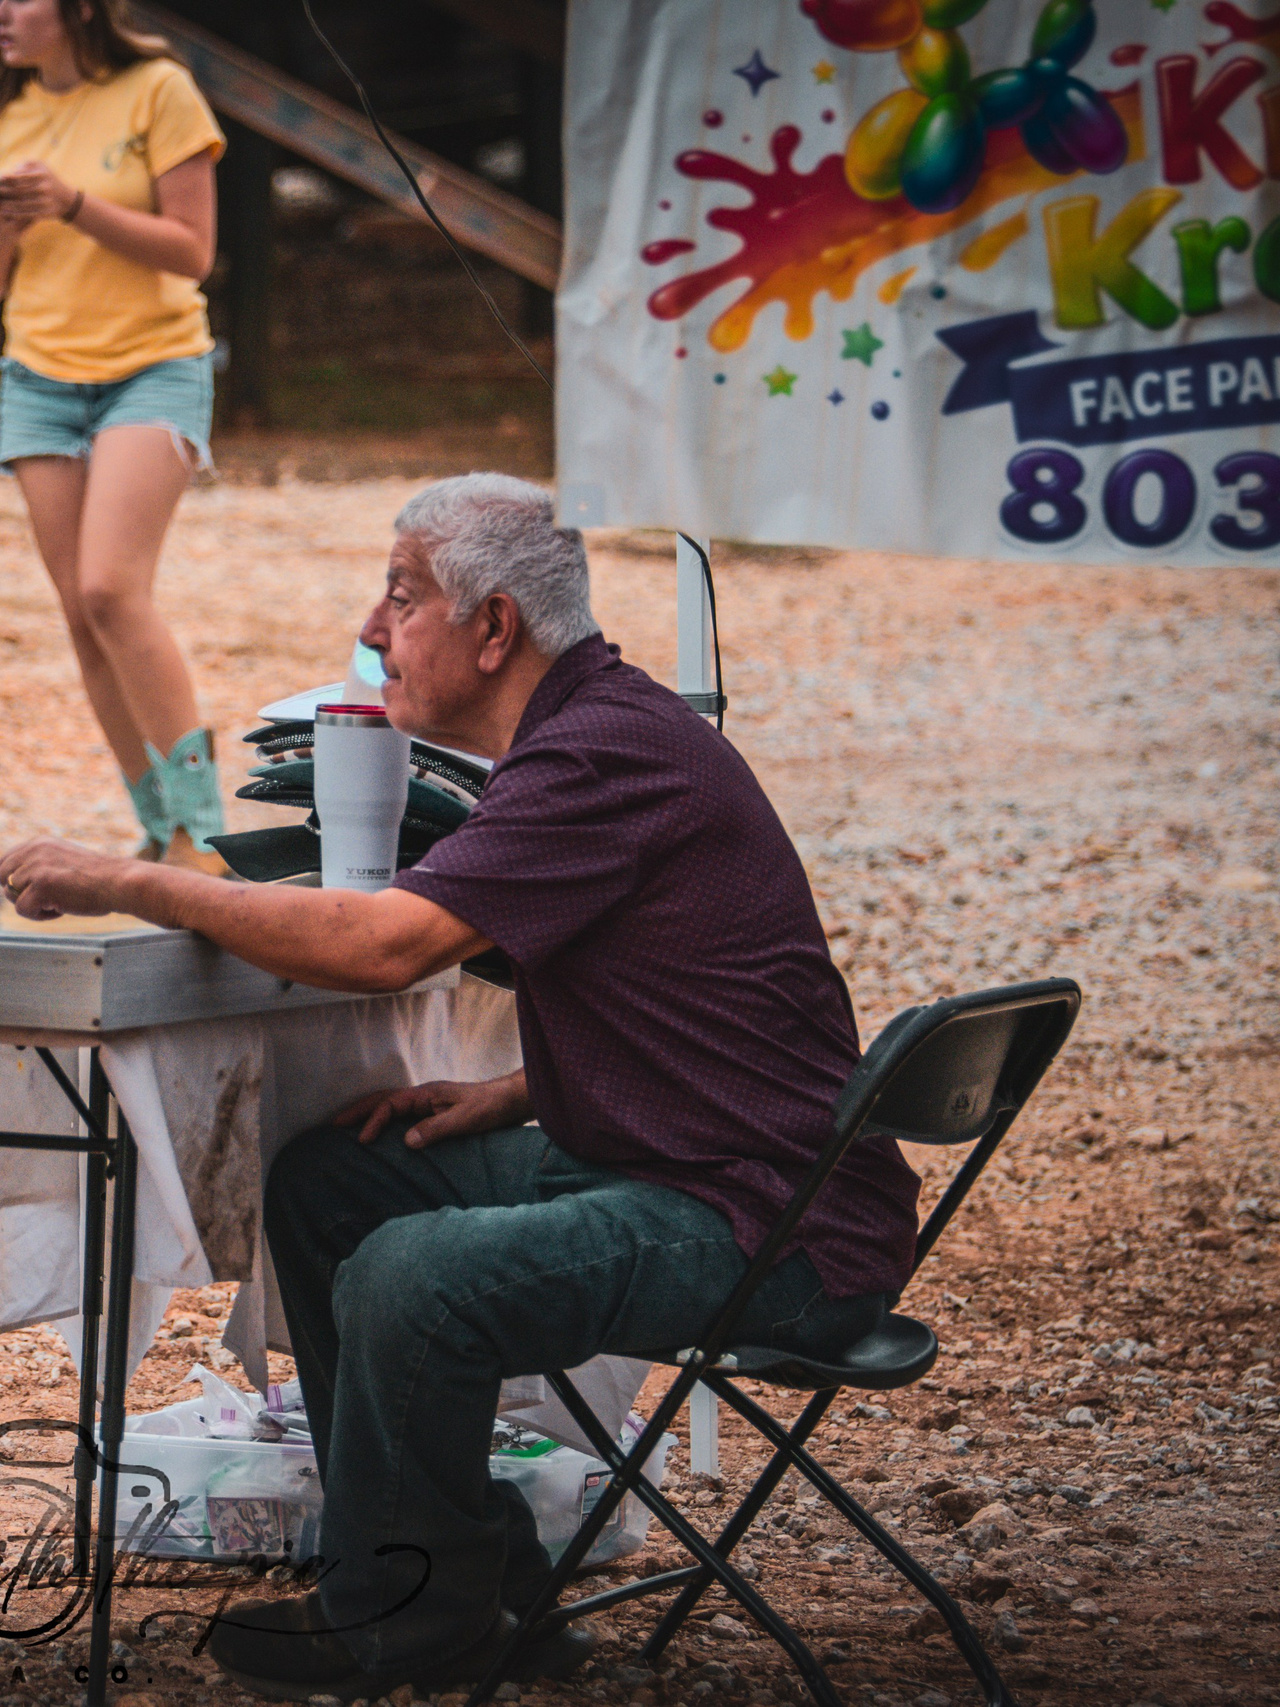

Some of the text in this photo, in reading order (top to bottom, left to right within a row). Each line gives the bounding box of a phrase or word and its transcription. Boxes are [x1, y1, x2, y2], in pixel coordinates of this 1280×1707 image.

[1155, 54, 1280, 192] K
[1070, 367, 1196, 428] FACE
[999, 447, 1280, 552] 803
[346, 867, 391, 876] YUKON
